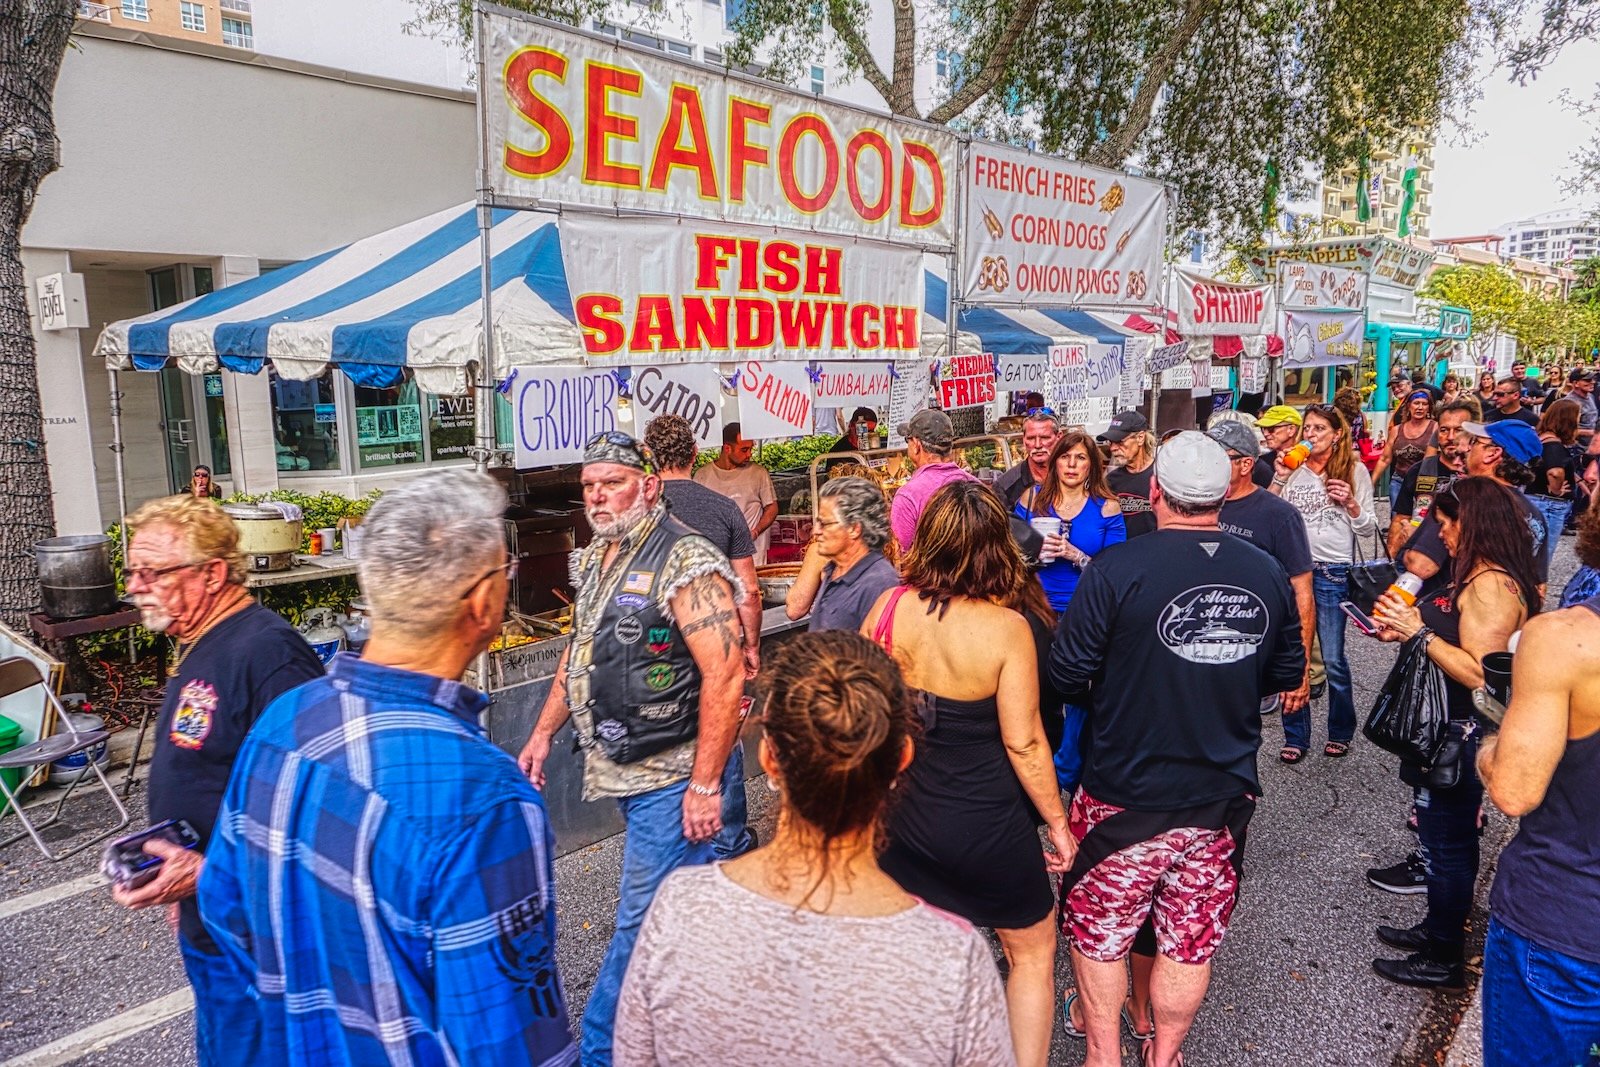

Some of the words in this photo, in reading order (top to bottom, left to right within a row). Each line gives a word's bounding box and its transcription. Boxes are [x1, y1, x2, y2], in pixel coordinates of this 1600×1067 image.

[503, 45, 945, 228] SEAFOOD
[975, 155, 1049, 198] FRENCH
[1053, 172, 1096, 206] FRIES
[1011, 213, 1060, 247] CORN
[1064, 221, 1108, 251] DOGS
[694, 233, 843, 297] FISH
[1306, 248, 1358, 264] APPLE
[1016, 263, 1072, 293] ONION
[1075, 268, 1120, 295] RINGS
[1192, 283, 1264, 324] SHRIMP
[575, 293, 919, 355] SANDWICH
[950, 354, 994, 377] CHEDDAR
[1053, 346, 1084, 367] CLAMS
[1091, 345, 1119, 390] SHRIMP
[1152, 345, 1168, 361] ICE
[817, 372, 890, 397] JUMBALAYA
[1005, 363, 1043, 382] GATOR
[636, 368, 716, 440] GATOR
[742, 360, 810, 429] SALMON
[941, 375, 996, 408] FRIES
[44, 416, 77, 424] TREAM
[428, 397, 474, 419] JEWE
[518, 374, 614, 451] GROUPER
[365, 451, 391, 462] brilliant
[392, 449, 417, 459] location
[437, 445, 464, 455] sparkling
[1200, 604, 1224, 618] At
[1225, 604, 1260, 619] Last
